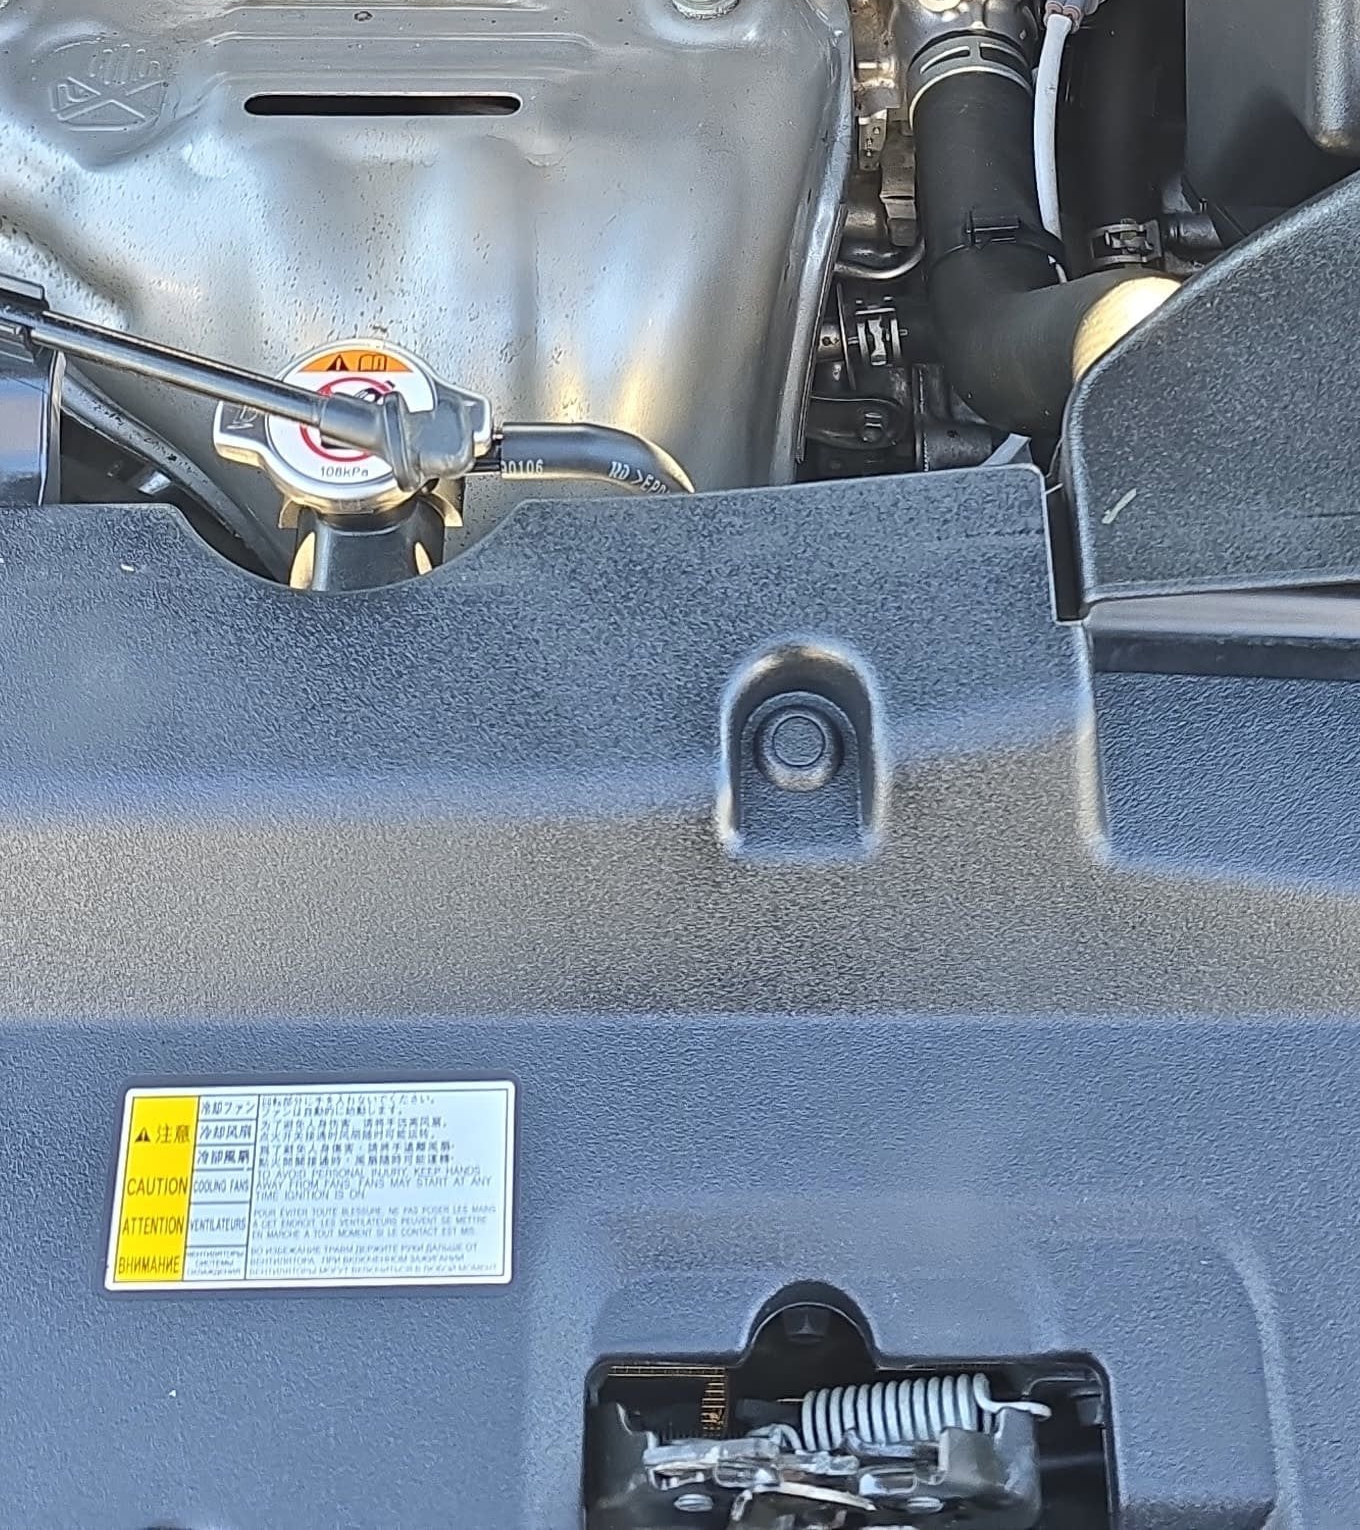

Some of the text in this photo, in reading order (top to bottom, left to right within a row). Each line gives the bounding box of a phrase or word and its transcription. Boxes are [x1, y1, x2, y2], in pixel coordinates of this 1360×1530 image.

[319, 465, 370, 478] 108kPa
[200, 1101, 256, 1116] 冷却ファン
[155, 1123, 191, 1144] 注意
[257, 1170, 271, 1181] TO
[274, 1169, 306, 1181] AVOID
[311, 1167, 363, 1180] PERSONAL
[414, 1166, 441, 1177] KEEP
[446, 1165, 481, 1176] HANDS
[126, 1177, 189, 1197] CAUTION
[193, 1178, 249, 1193] COOLING FANS
[255, 1179, 285, 1191] AWAY
[288, 1178, 320, 1190] FROM
[357, 1176, 385, 1189] FANS
[389, 1176, 411, 1188] MAY
[416, 1176, 447, 1188] START
[452, 1176, 465, 1187] AT
[470, 1175, 492, 1187] ANY
[256, 1190, 279, 1202] TIME
[285, 1189, 329, 1201] IGNITION
[334, 1188, 345, 1200] IS
[122, 1216, 185, 1236] ATTENTION
[190, 1217, 247, 1232] VENTILATEURS
[118, 1255, 181, 1275] ВНИМАНИЕ
